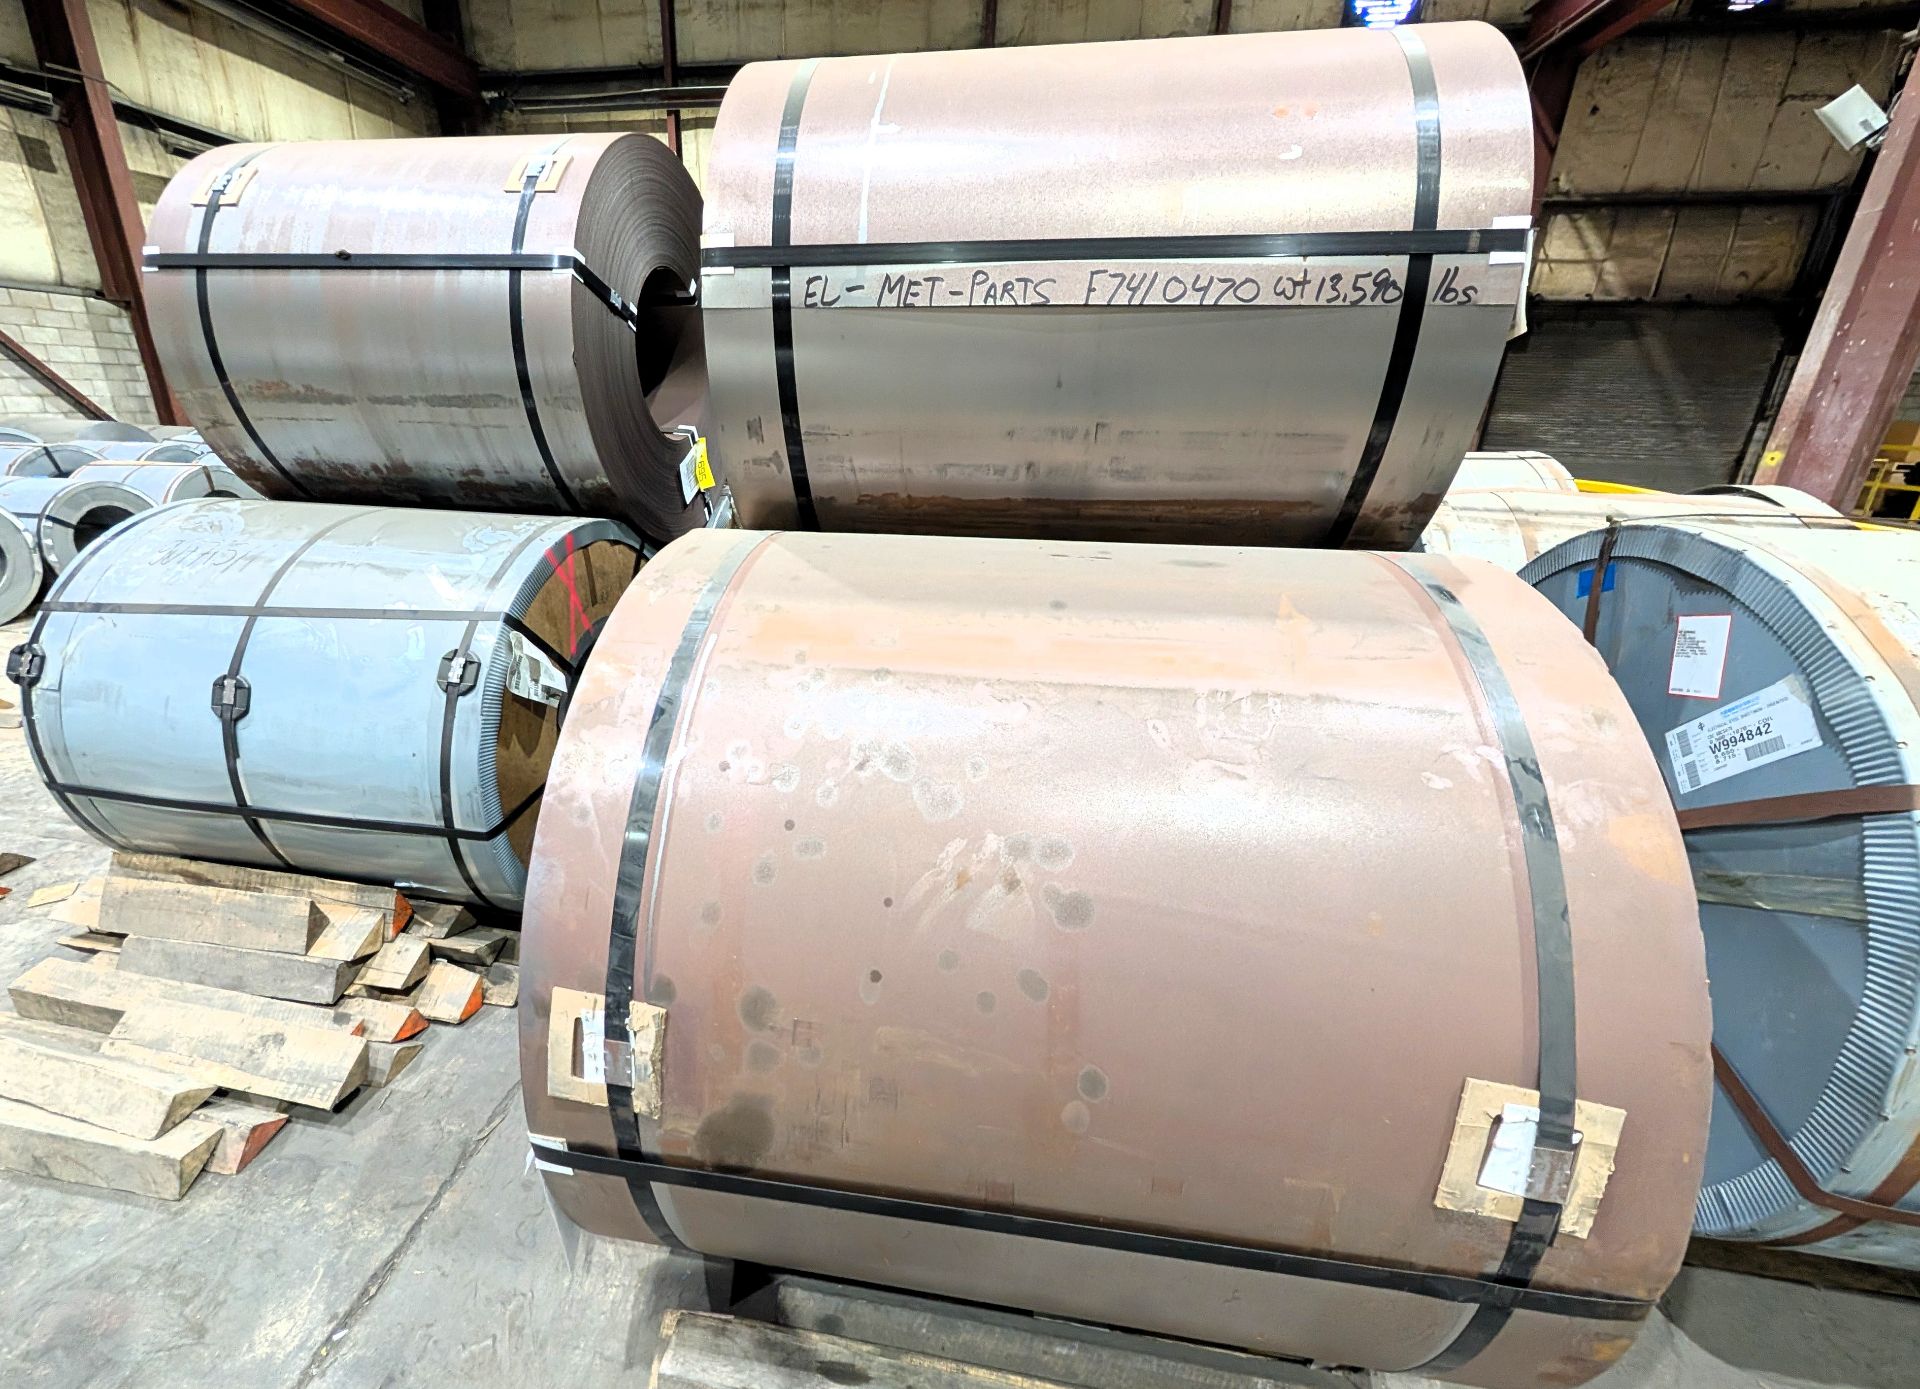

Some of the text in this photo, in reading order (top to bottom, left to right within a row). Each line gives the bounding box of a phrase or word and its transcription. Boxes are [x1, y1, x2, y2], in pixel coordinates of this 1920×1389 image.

[1084, 268, 1261, 306] F7410470
[1432, 266, 1478, 305] lbs
[1708, 722, 1773, 755] W994842
